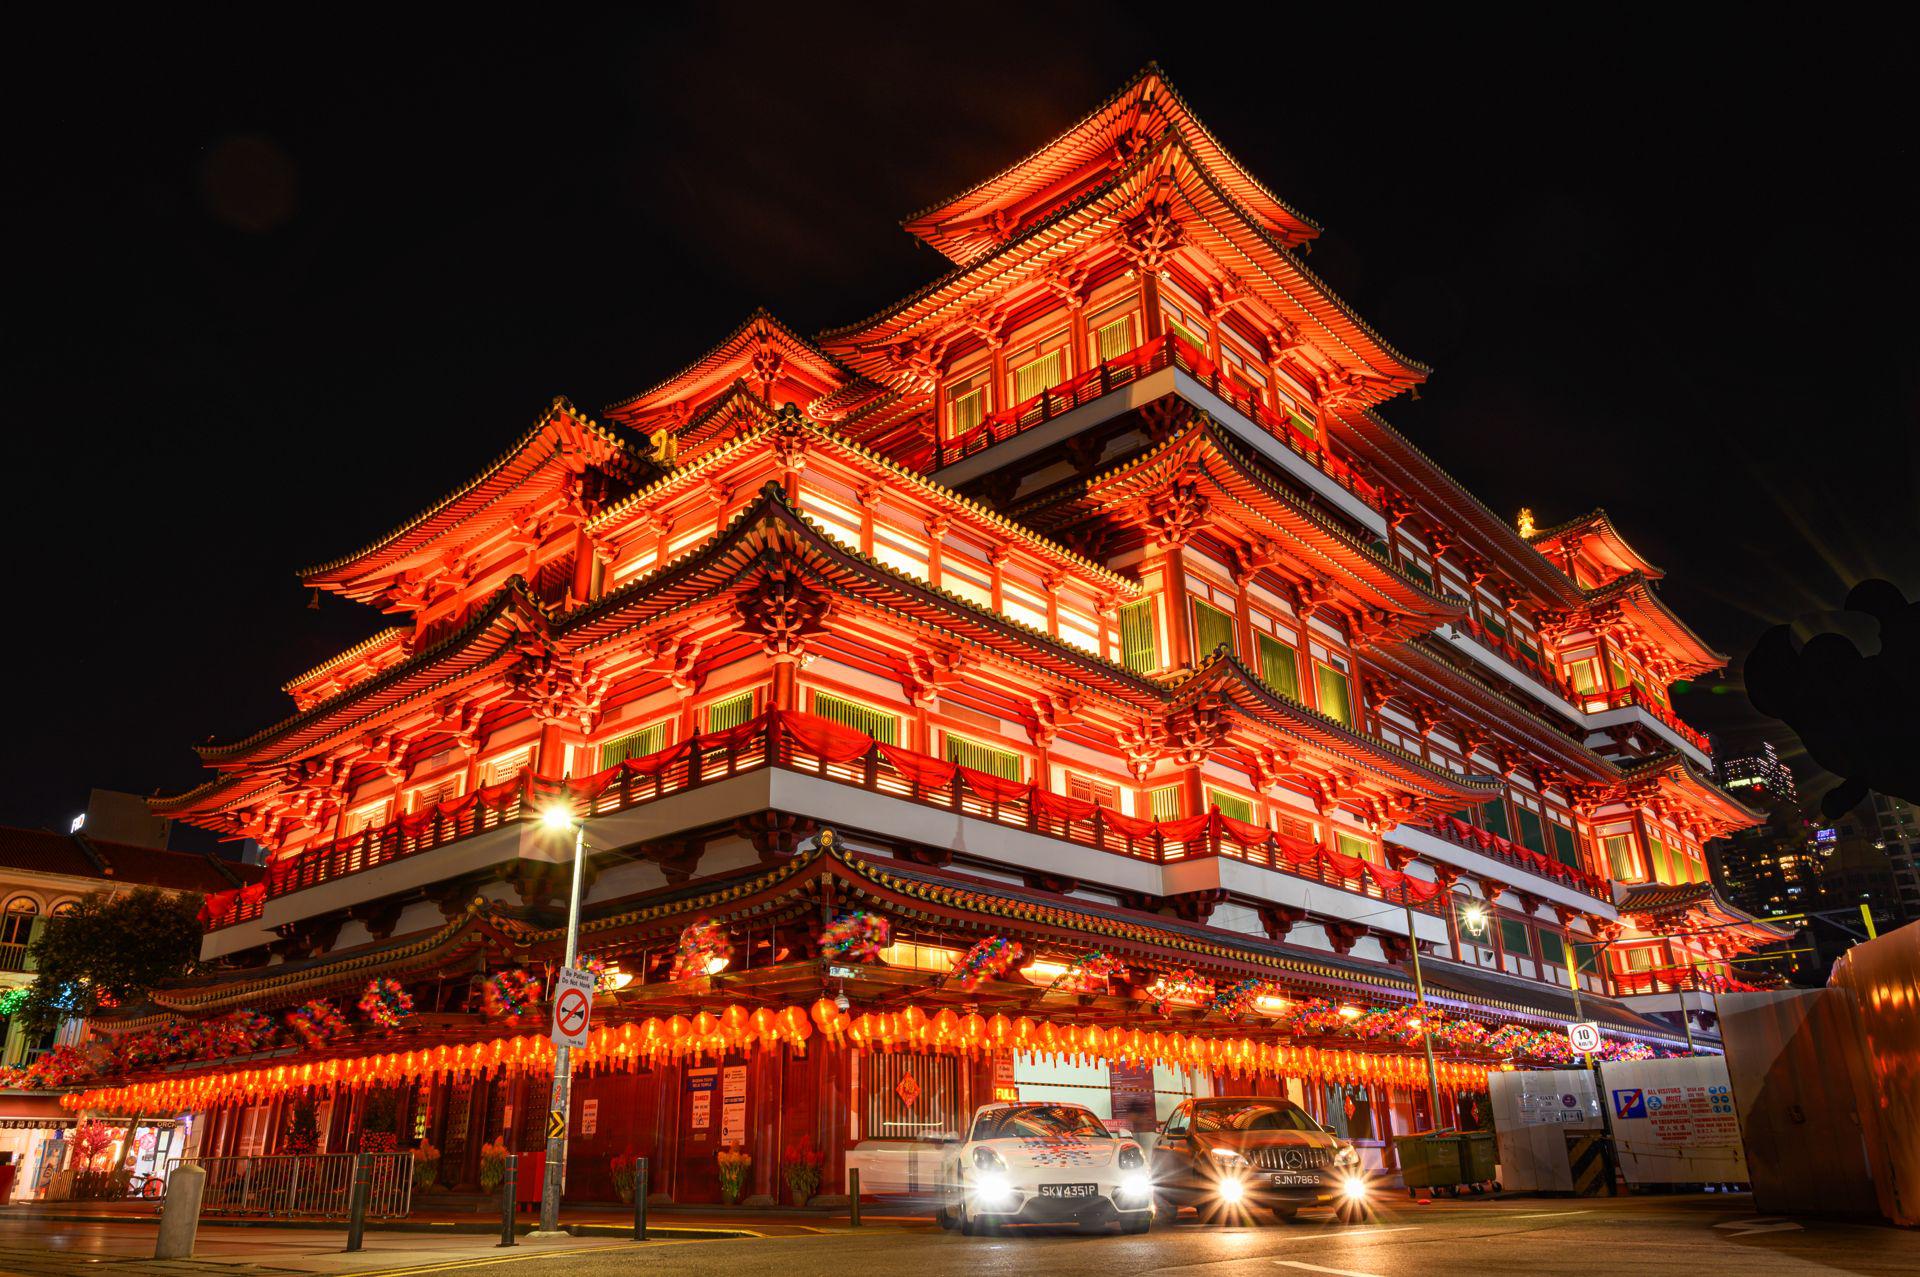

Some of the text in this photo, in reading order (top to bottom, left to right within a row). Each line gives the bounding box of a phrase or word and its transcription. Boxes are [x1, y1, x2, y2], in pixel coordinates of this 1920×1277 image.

[573, 971, 589, 982] Patient
[570, 978, 578, 986] Not
[1577, 1029, 1590, 1040] 10
[996, 1088, 1017, 1100] FULL
[1665, 1095, 1681, 1103] MUST
[1274, 1175, 1320, 1184] SJN1786S
